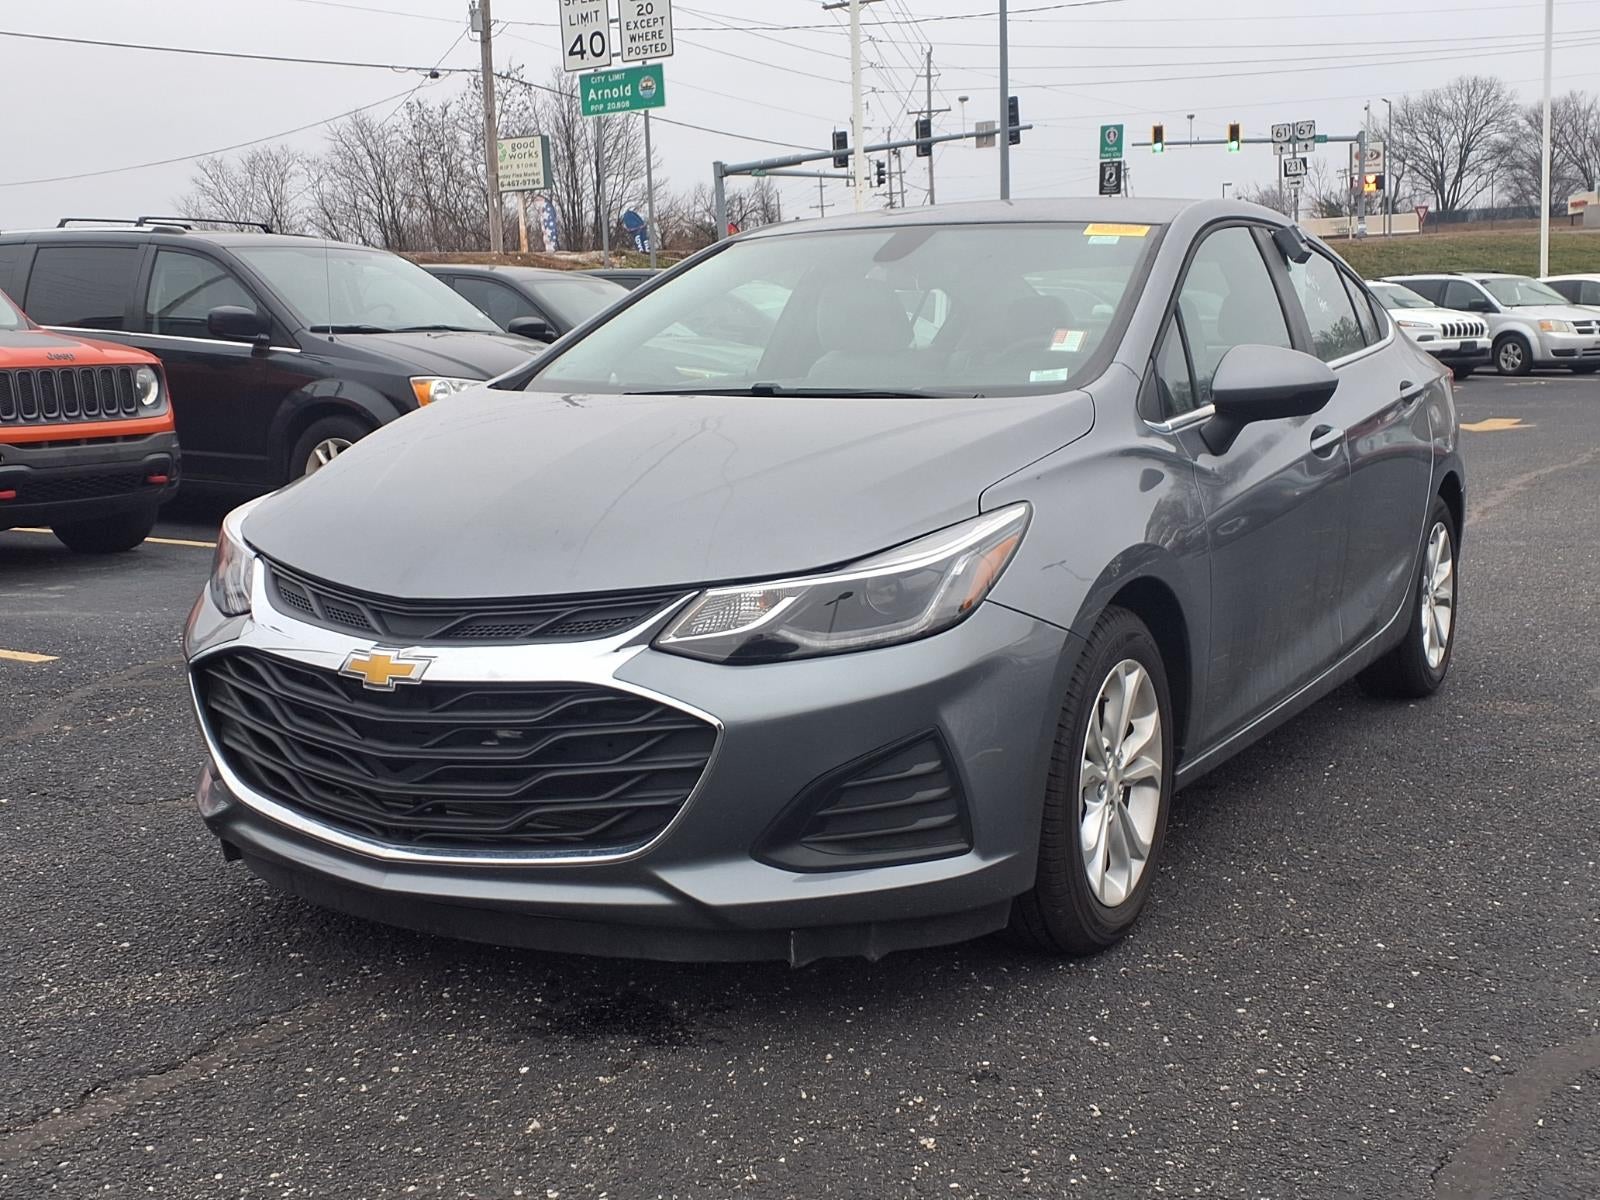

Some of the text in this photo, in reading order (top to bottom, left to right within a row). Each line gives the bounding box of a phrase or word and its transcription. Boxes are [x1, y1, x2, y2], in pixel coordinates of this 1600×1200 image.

[636, 2, 654, 17] 20
[569, 9, 600, 27] LIMIT
[626, 16, 666, 30] EXCEPT
[629, 29, 664, 43] WHERE
[568, 31, 606, 60] 40
[627, 43, 668, 57] POSTED
[590, 72, 626, 84] CITY LIMIT
[588, 83, 632, 102] Arnold
[1275, 127, 1287, 138] 61
[1298, 124, 1313, 135] 67
[511, 139, 535, 152] good
[508, 150, 539, 160] works
[1287, 161, 1302, 172] 231
